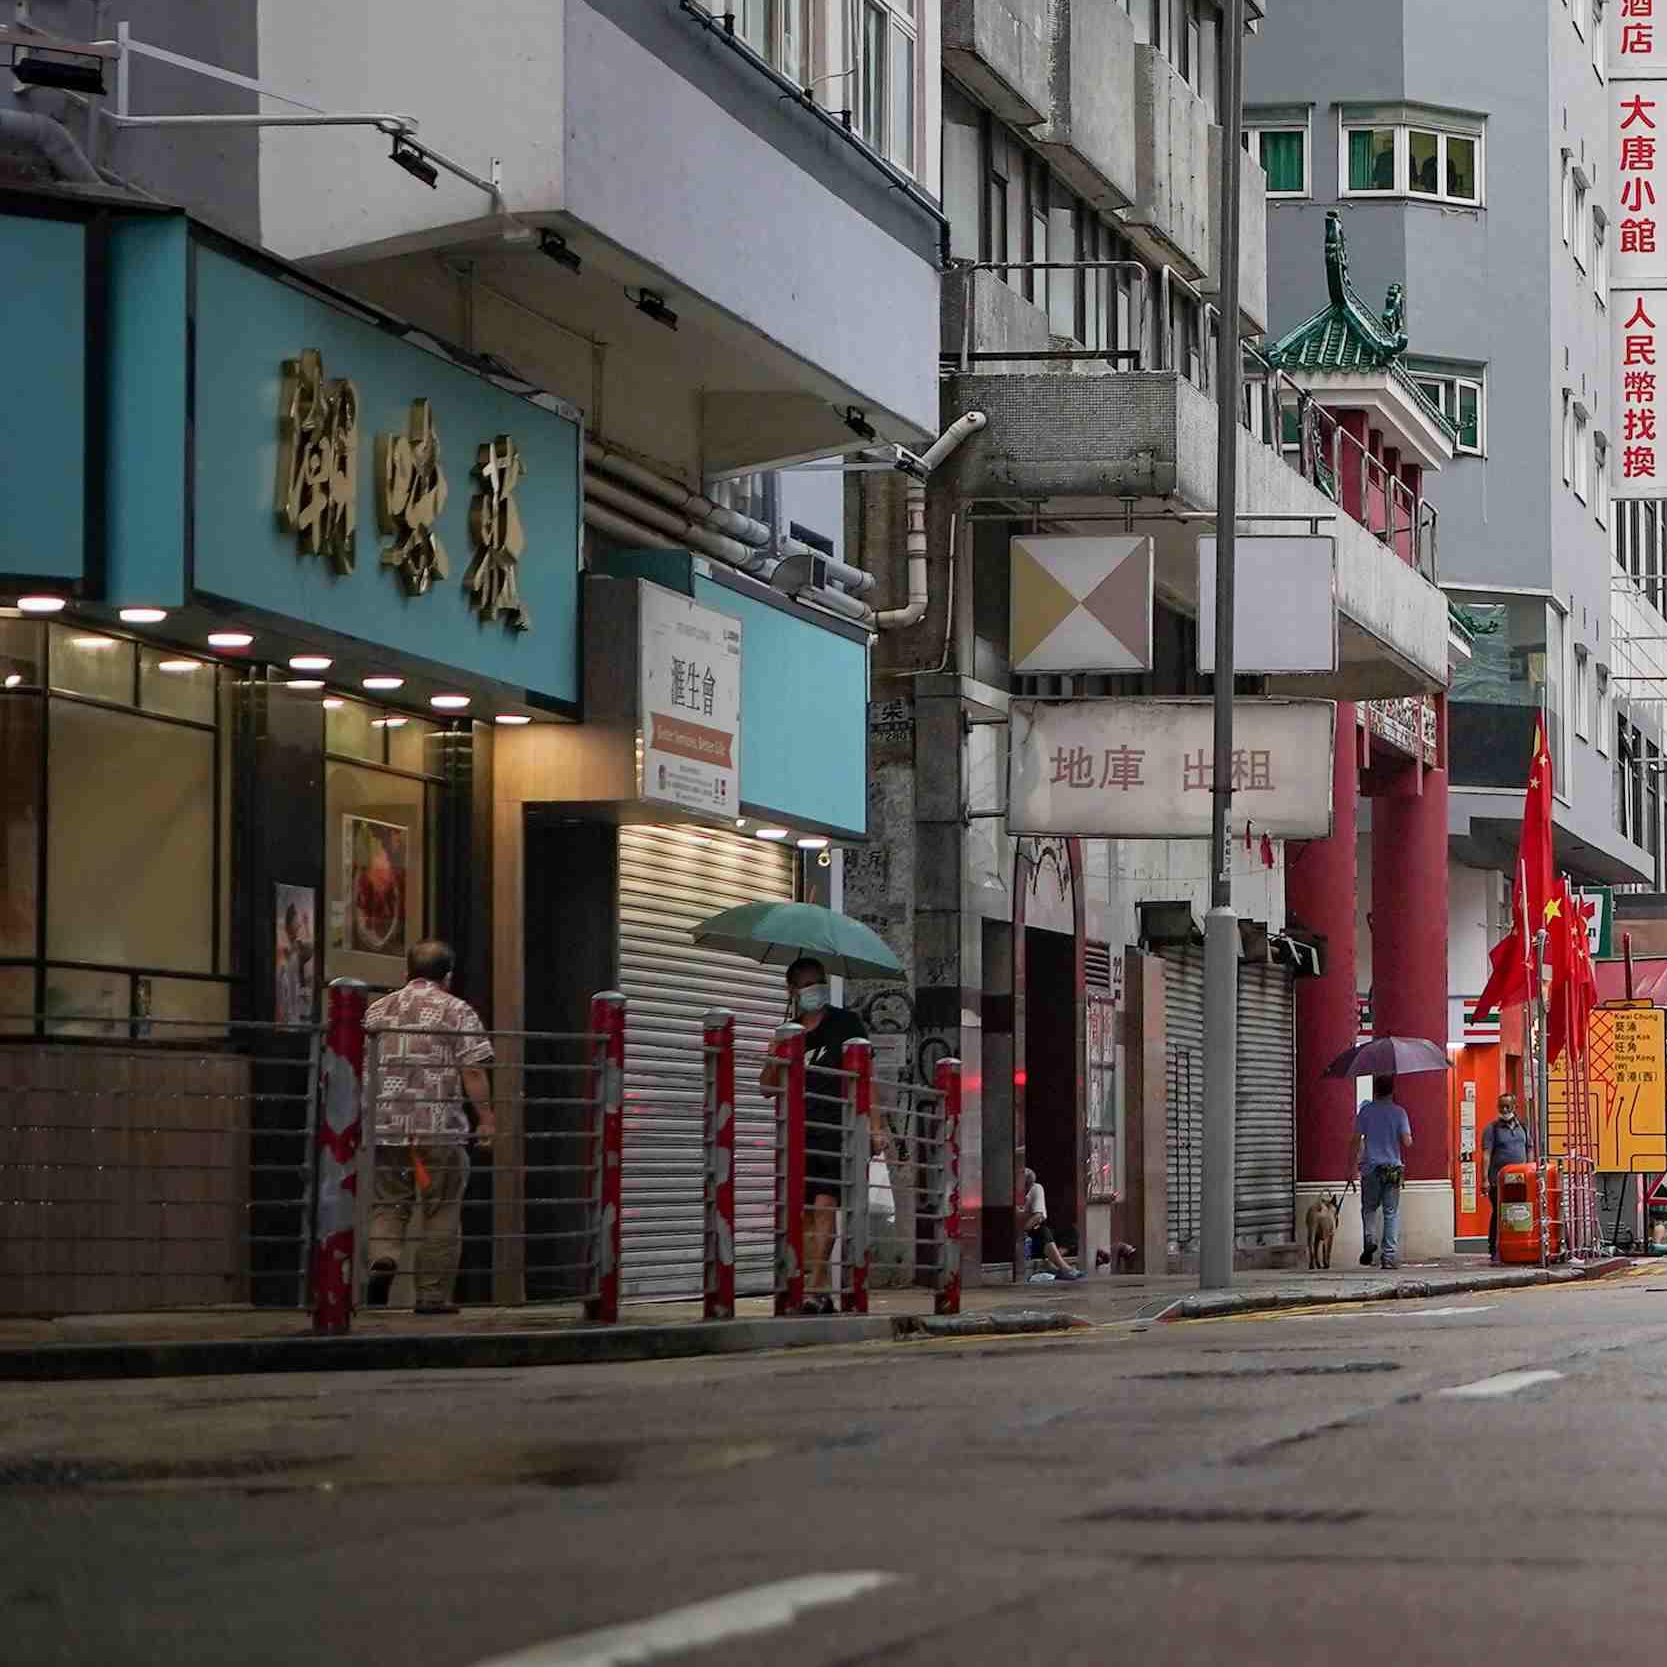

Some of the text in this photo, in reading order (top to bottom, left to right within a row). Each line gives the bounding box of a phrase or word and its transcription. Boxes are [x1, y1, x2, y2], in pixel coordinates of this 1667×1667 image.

[1618, 93, 1658, 255] 大唐小館
[1621, 295, 1658, 480] 人民幣找換
[1049, 744, 1276, 793] 地庫 出租
[1614, 1012, 1658, 1022] Kwai Chung
[1614, 1022, 1637, 1033] 葵涌
[1614, 1034, 1634, 1042] Mong
[1614, 1042, 1637, 1054] 旺角
[1614, 1055, 1656, 1063] Hong Kong
[1615, 1071, 1658, 1083] 香港(西)
